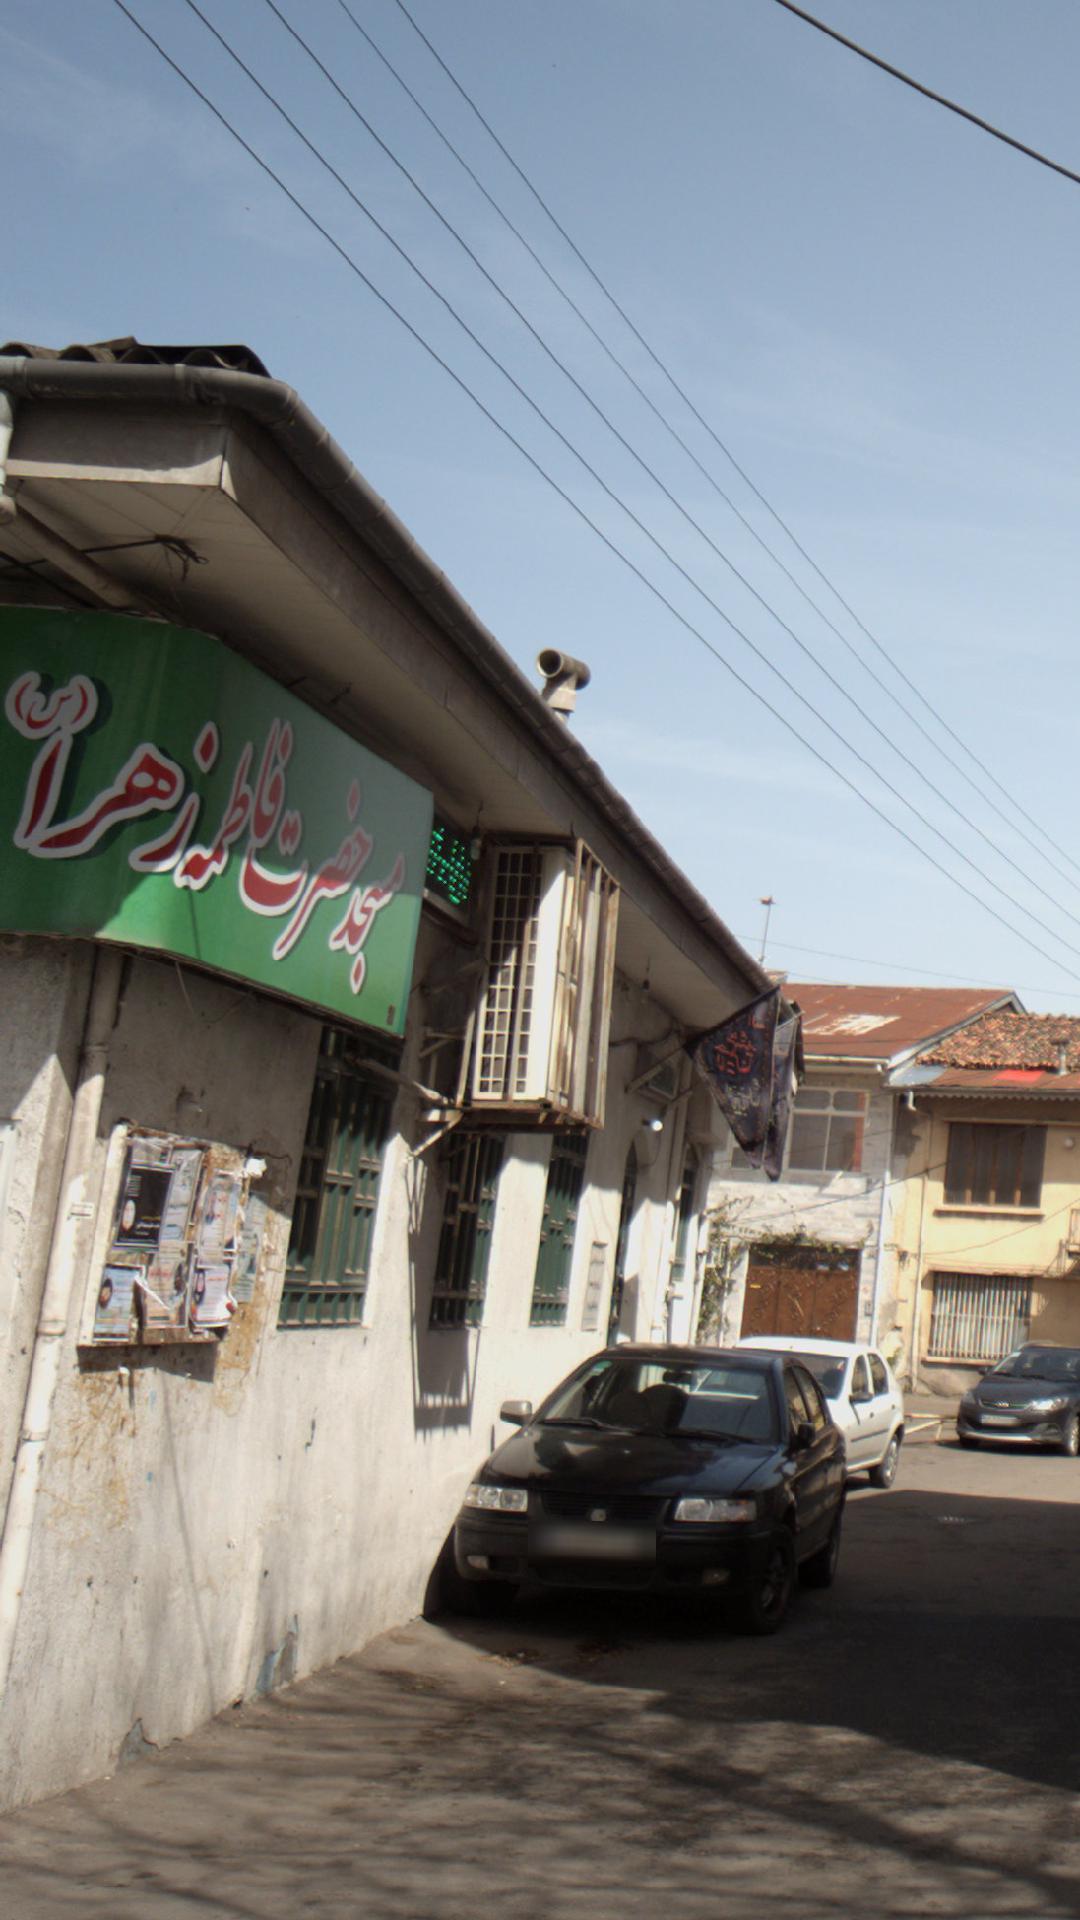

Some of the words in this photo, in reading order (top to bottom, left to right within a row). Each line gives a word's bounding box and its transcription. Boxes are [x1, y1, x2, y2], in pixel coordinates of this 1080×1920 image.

[13, 720, 219, 873] زهرا
[174, 717, 294, 890] فاطمه
[239, 778, 373, 961] حضرت
[329, 855, 405, 995] مسجد
